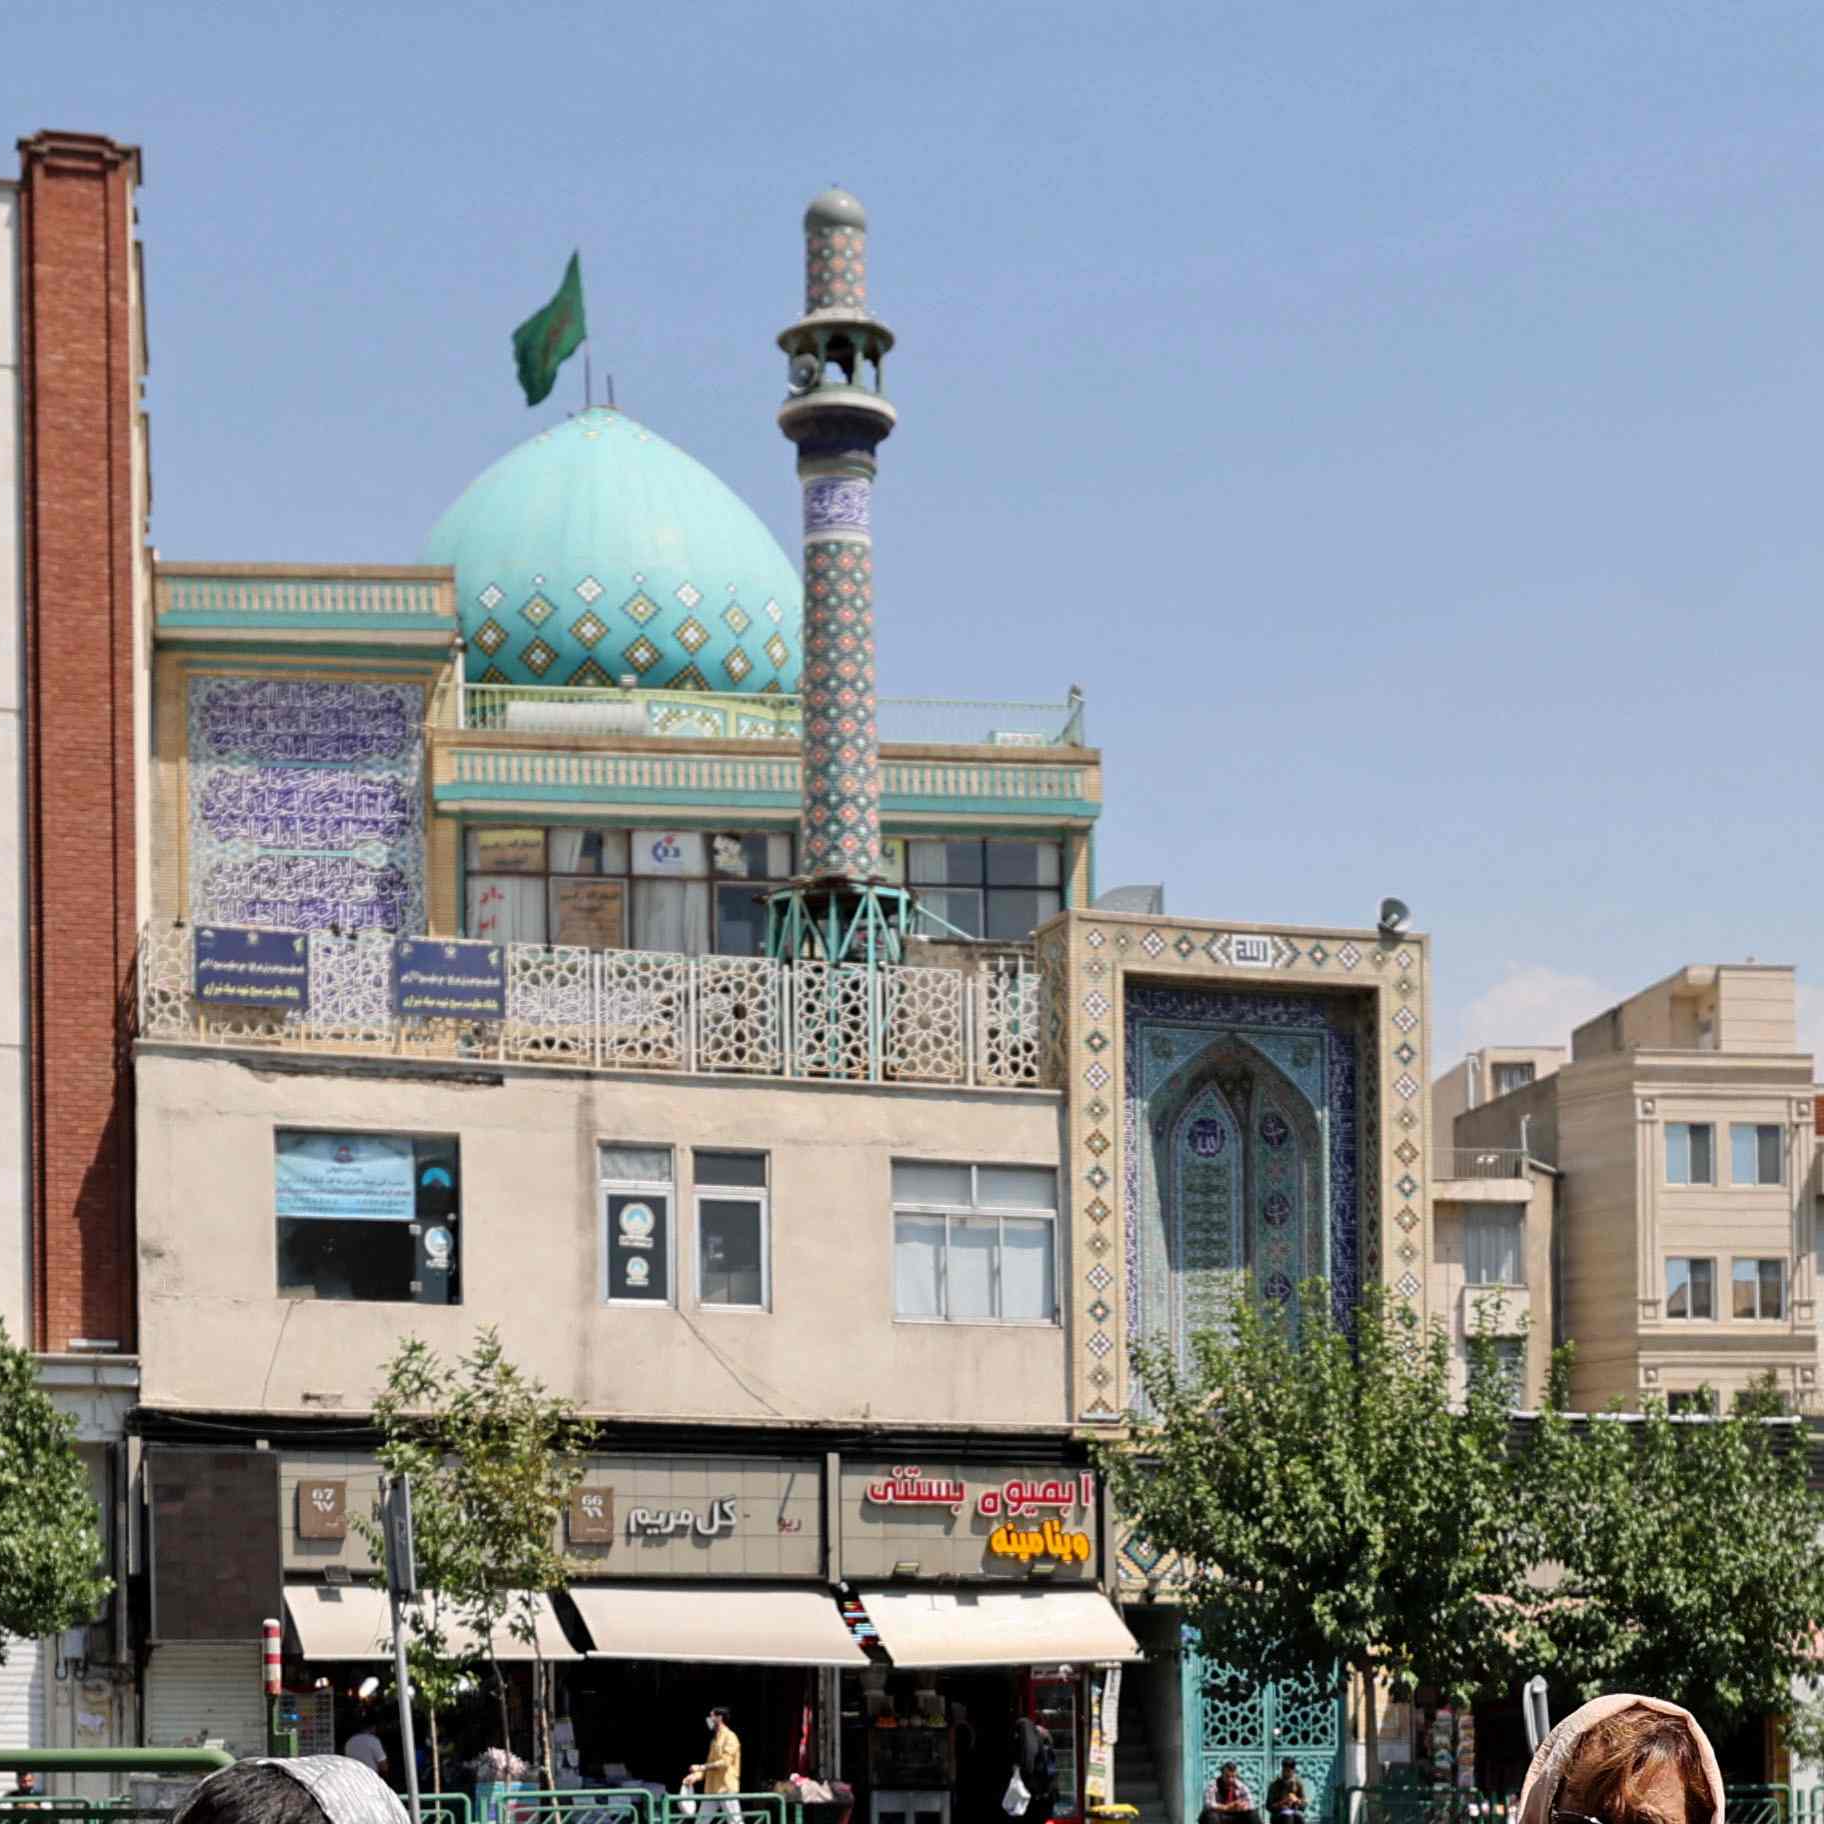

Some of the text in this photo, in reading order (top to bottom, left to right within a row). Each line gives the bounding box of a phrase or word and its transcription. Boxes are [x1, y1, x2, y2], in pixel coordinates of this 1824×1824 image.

[311, 1488, 335, 1501] 67
[581, 1495, 603, 1506] 66
[868, 1464, 966, 1515] بستنی
[627, 1494, 738, 1536] گل مریم
